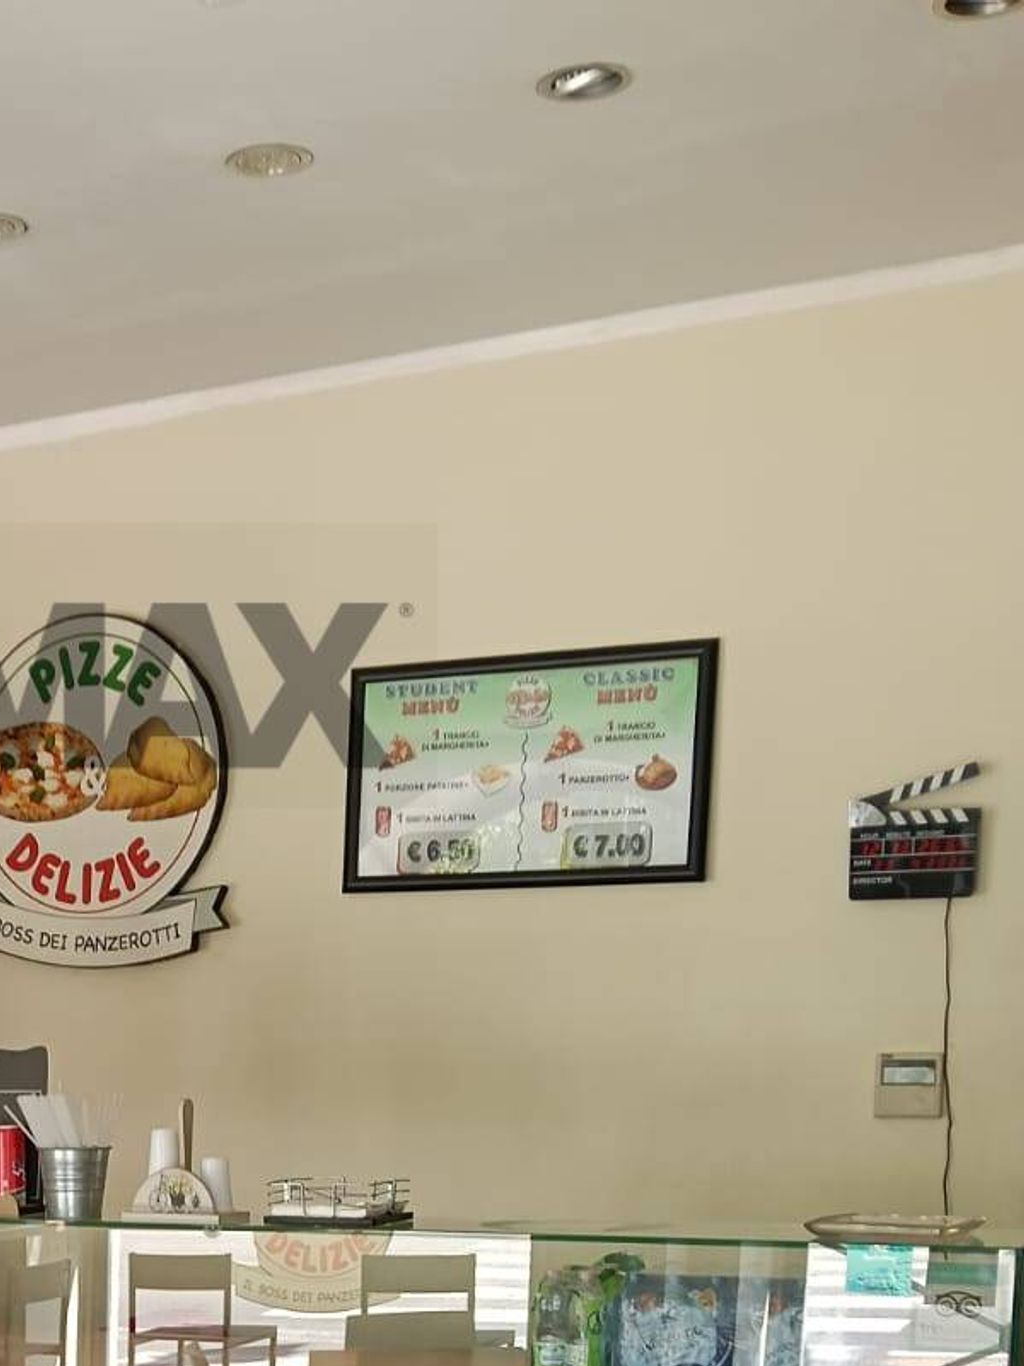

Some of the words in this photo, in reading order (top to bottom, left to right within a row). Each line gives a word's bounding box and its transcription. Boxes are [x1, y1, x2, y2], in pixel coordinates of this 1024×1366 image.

[29, 641, 162, 706] PIZZE
[583, 667, 675, 686] CLASSIC
[385, 679, 479, 699] STUDENT
[80, 754, 106, 797] &
[594, 833, 647, 858] 7.00
[5, 833, 161, 904] DELIZIE
[39, 930, 68, 951] DEI
[74, 923, 182, 953] PANZEROTTI
